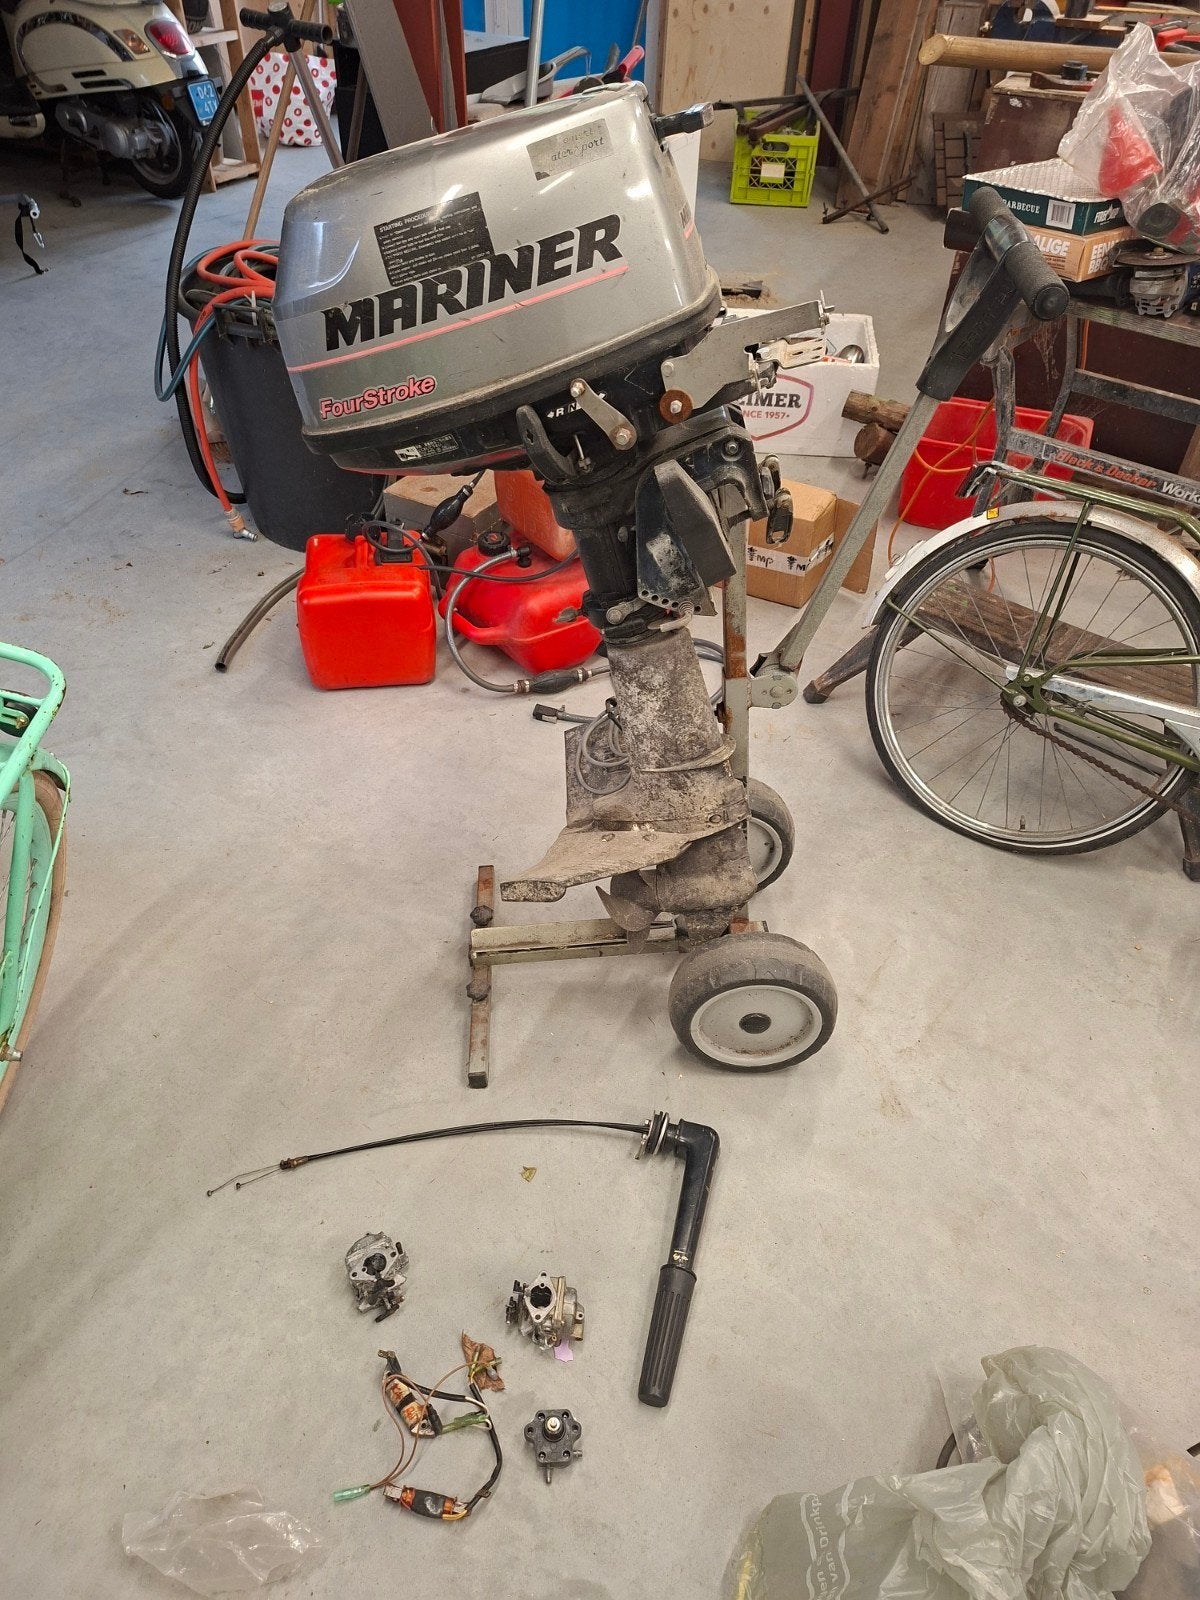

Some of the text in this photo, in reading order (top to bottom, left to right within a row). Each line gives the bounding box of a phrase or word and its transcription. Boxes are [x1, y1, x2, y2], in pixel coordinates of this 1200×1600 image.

[320, 214, 624, 351] MARINER
[319, 375, 437, 420] FourStroke
[739, 392, 802, 409] IMER
[1055, 449, 1093, 470] Black
[826, 1551, 838, 1582] van
